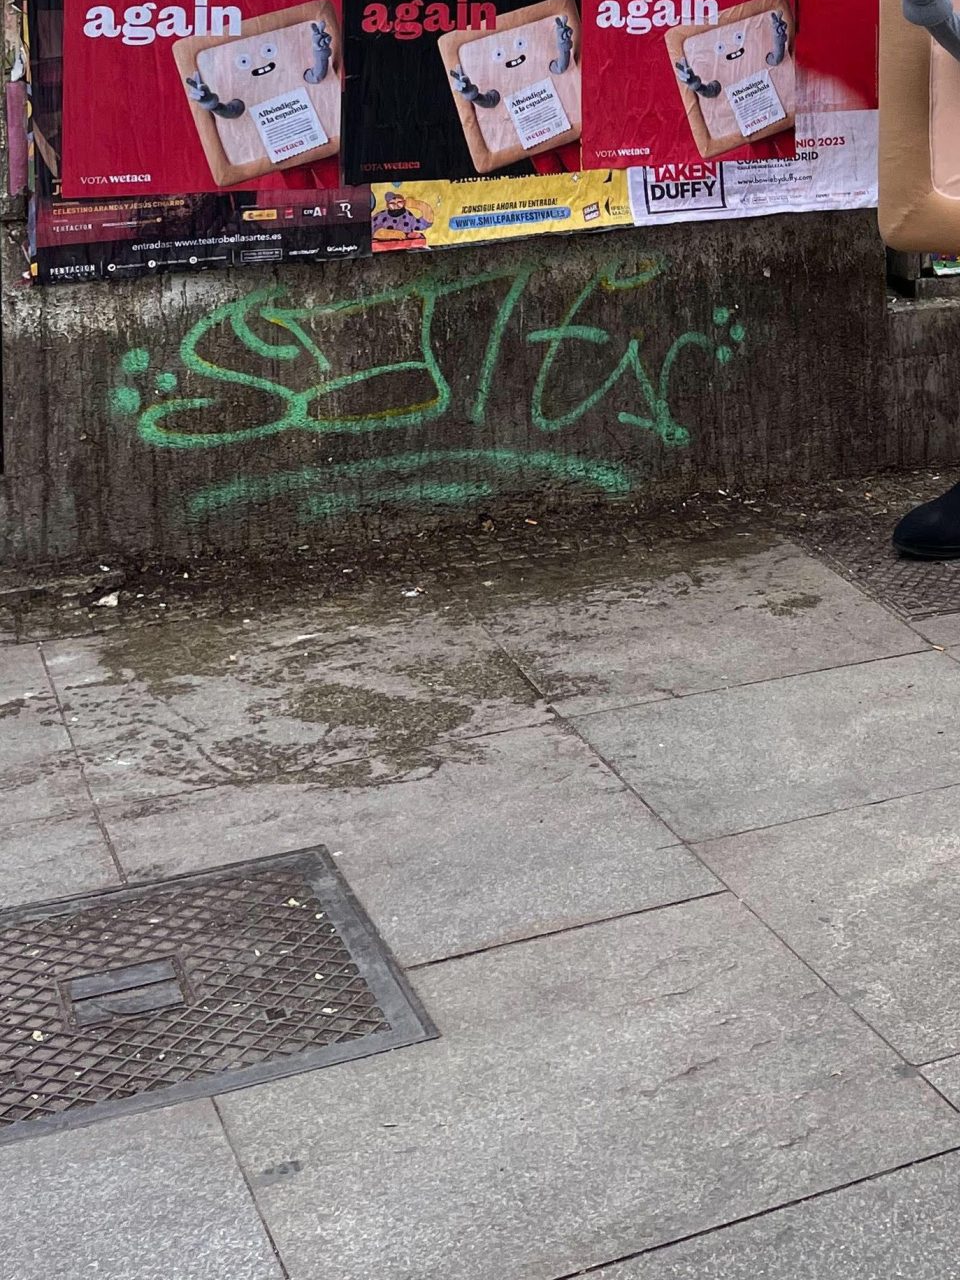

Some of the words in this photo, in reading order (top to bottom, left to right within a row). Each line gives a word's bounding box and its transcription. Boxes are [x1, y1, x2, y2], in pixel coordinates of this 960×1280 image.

[274, 138, 305, 155] wetaca
[818, 136, 846, 147] 2023
[595, 150, 617, 158] VOTA
[617, 147, 650, 156] wetaca
[80, 176, 108, 185] VOTA
[109, 173, 151, 183] wetaca
[649, 161, 717, 183] TAKEN
[737, 173, 813, 185] www.bowiebyduffy.com
[651, 180, 716, 201] DUFFY
[496, 201, 517, 210] AHORA
[519, 200, 527, 209] TU
[527, 197, 558, 208] ENTRADA!
[455, 209, 566, 228] WWW.SMILEPARKFESTIVAL.ES
[132, 240, 173, 251] entradas:
[174, 232, 282, 247] www.teatrobellasartes.es
